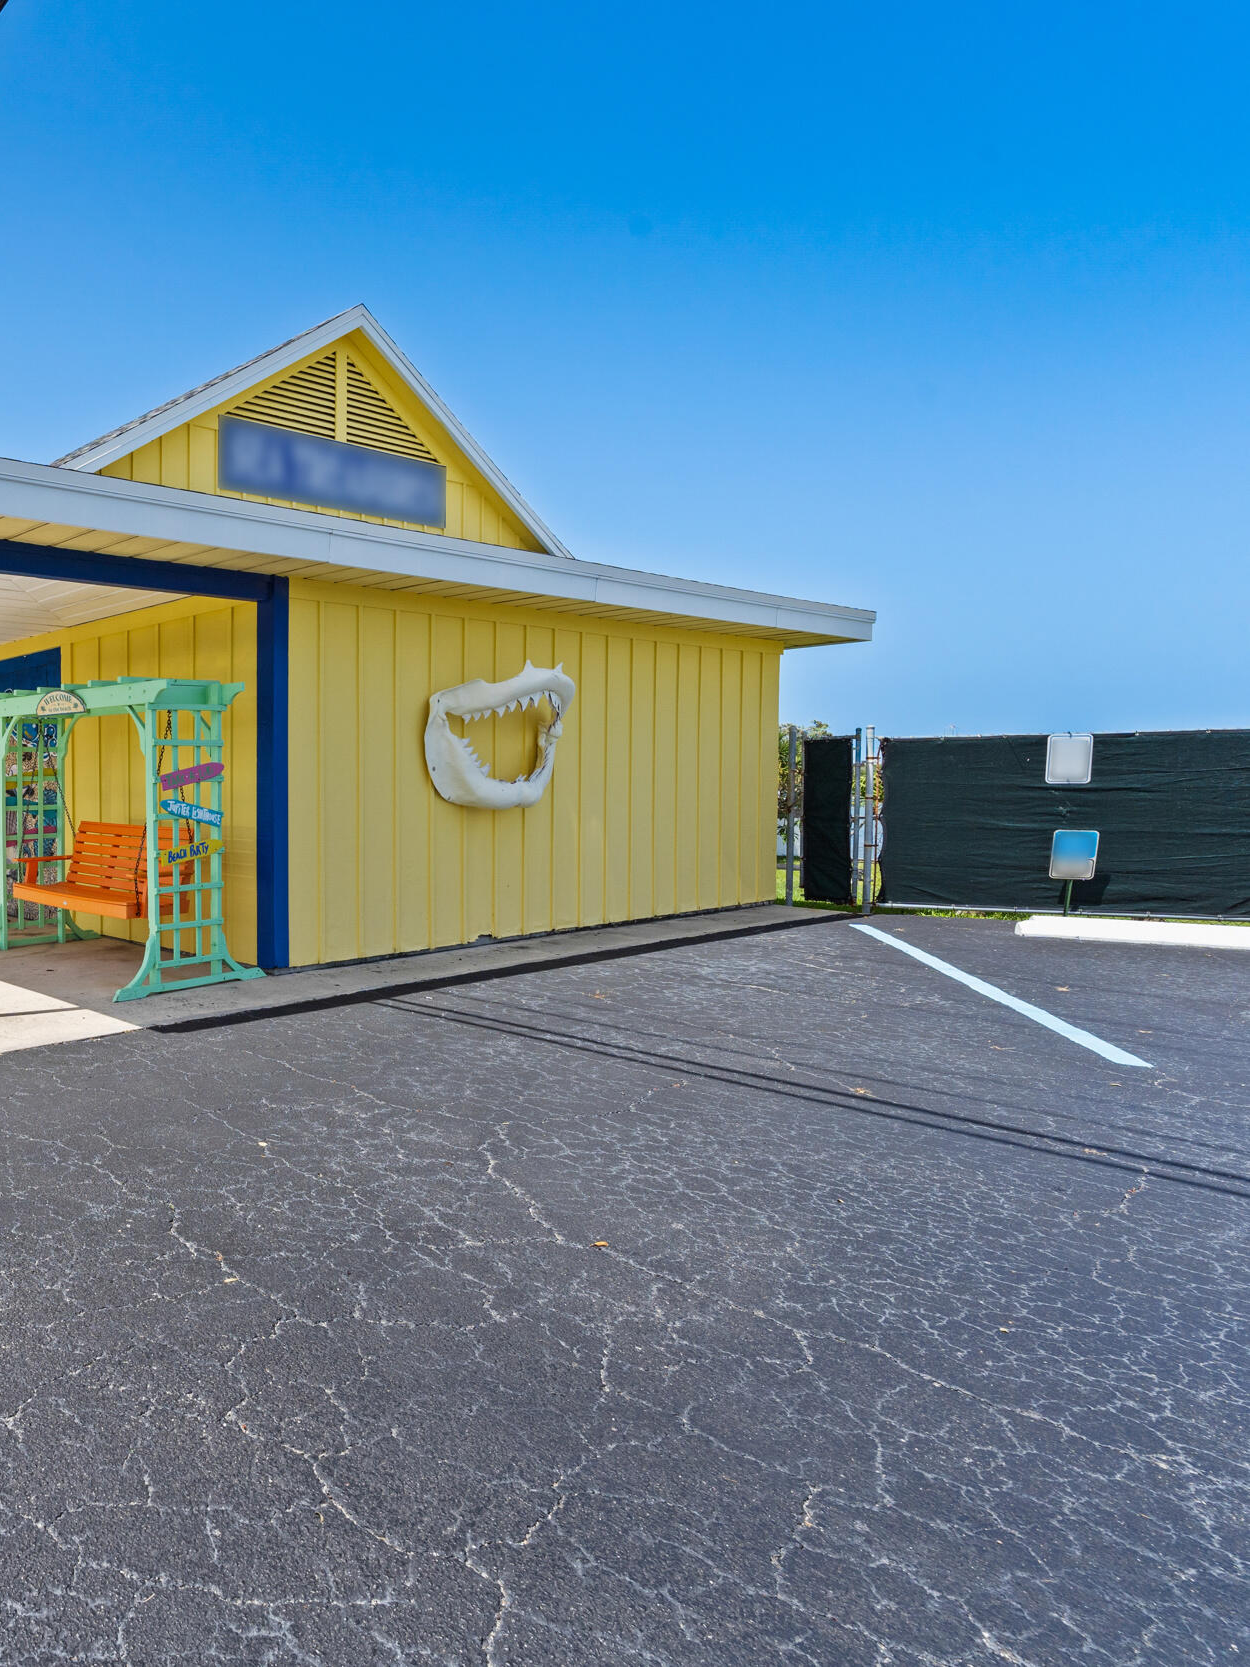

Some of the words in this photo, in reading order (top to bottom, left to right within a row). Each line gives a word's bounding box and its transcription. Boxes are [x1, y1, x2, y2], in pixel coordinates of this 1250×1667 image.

[43, 693, 72, 706] WELCOME
[167, 850, 188, 864] BEACH
[189, 841, 210, 858] PARTY
